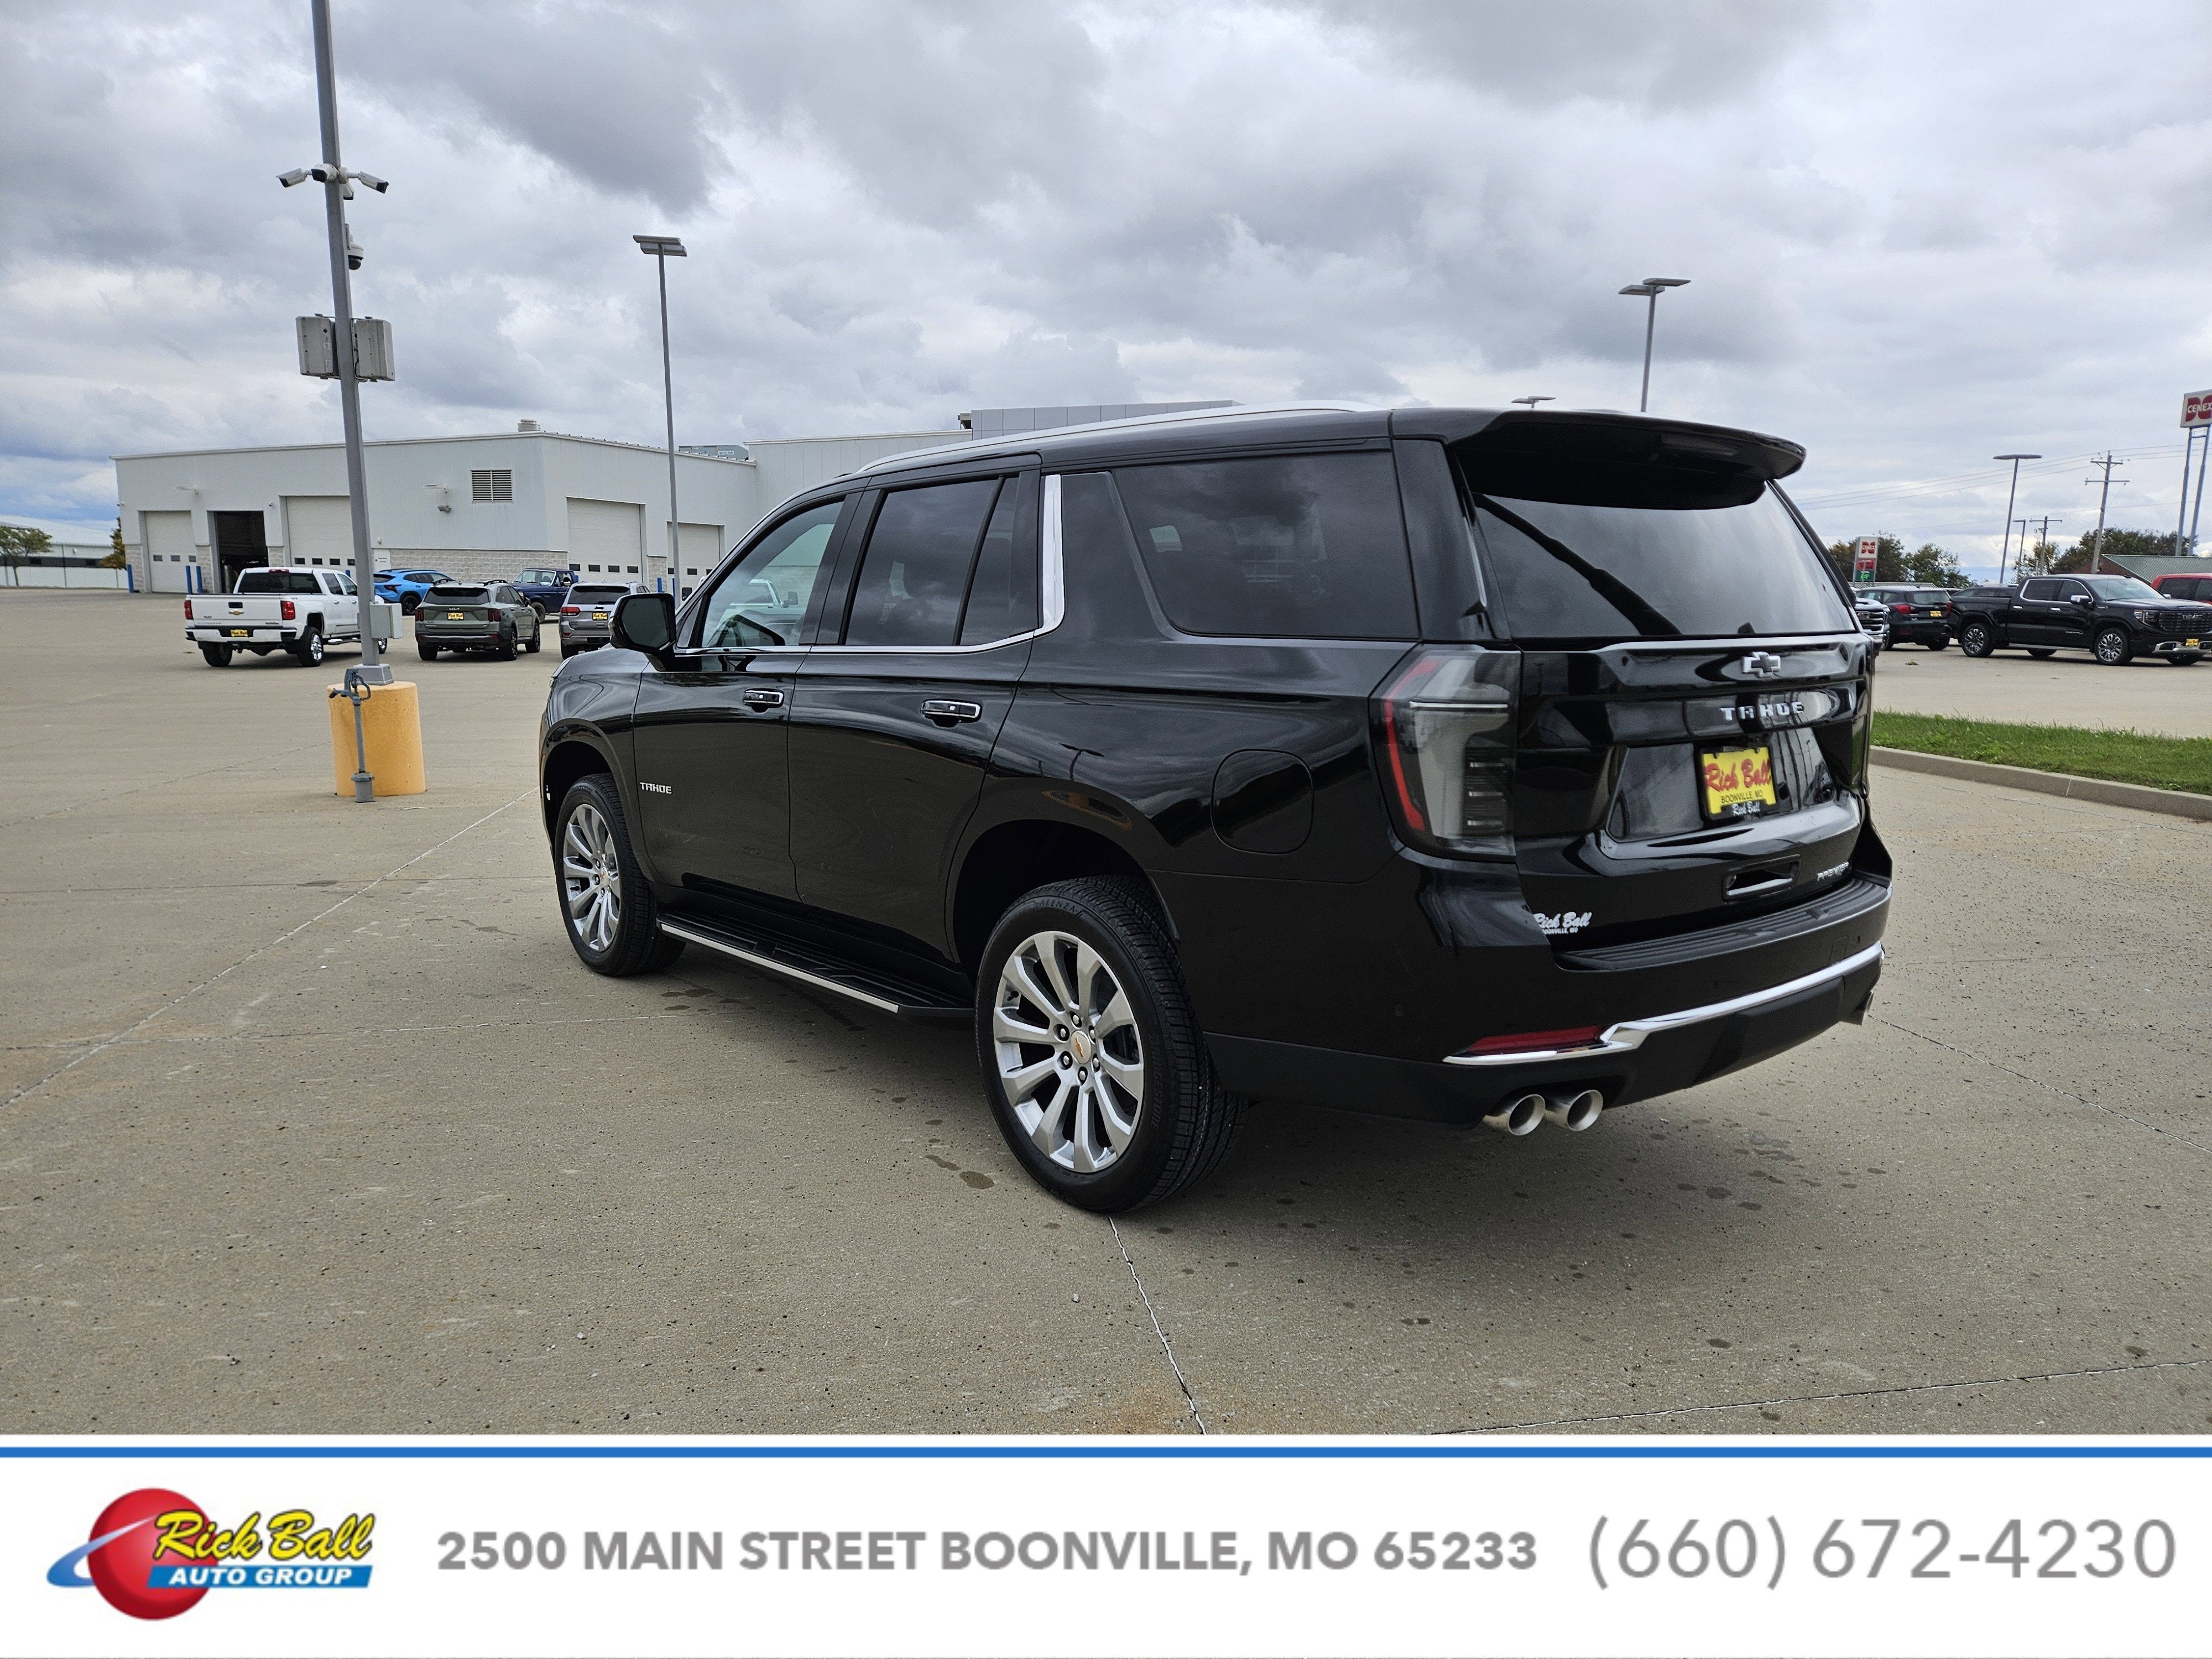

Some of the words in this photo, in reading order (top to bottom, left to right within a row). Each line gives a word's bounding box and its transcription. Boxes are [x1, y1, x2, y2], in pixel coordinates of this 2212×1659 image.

[1720, 702, 1804, 721] TAHOE
[1704, 763, 1739, 792] Rick
[1741, 758, 1771, 788] Ball
[639, 782, 672, 794] TAHOE
[1562, 911, 1592, 928] Ball
